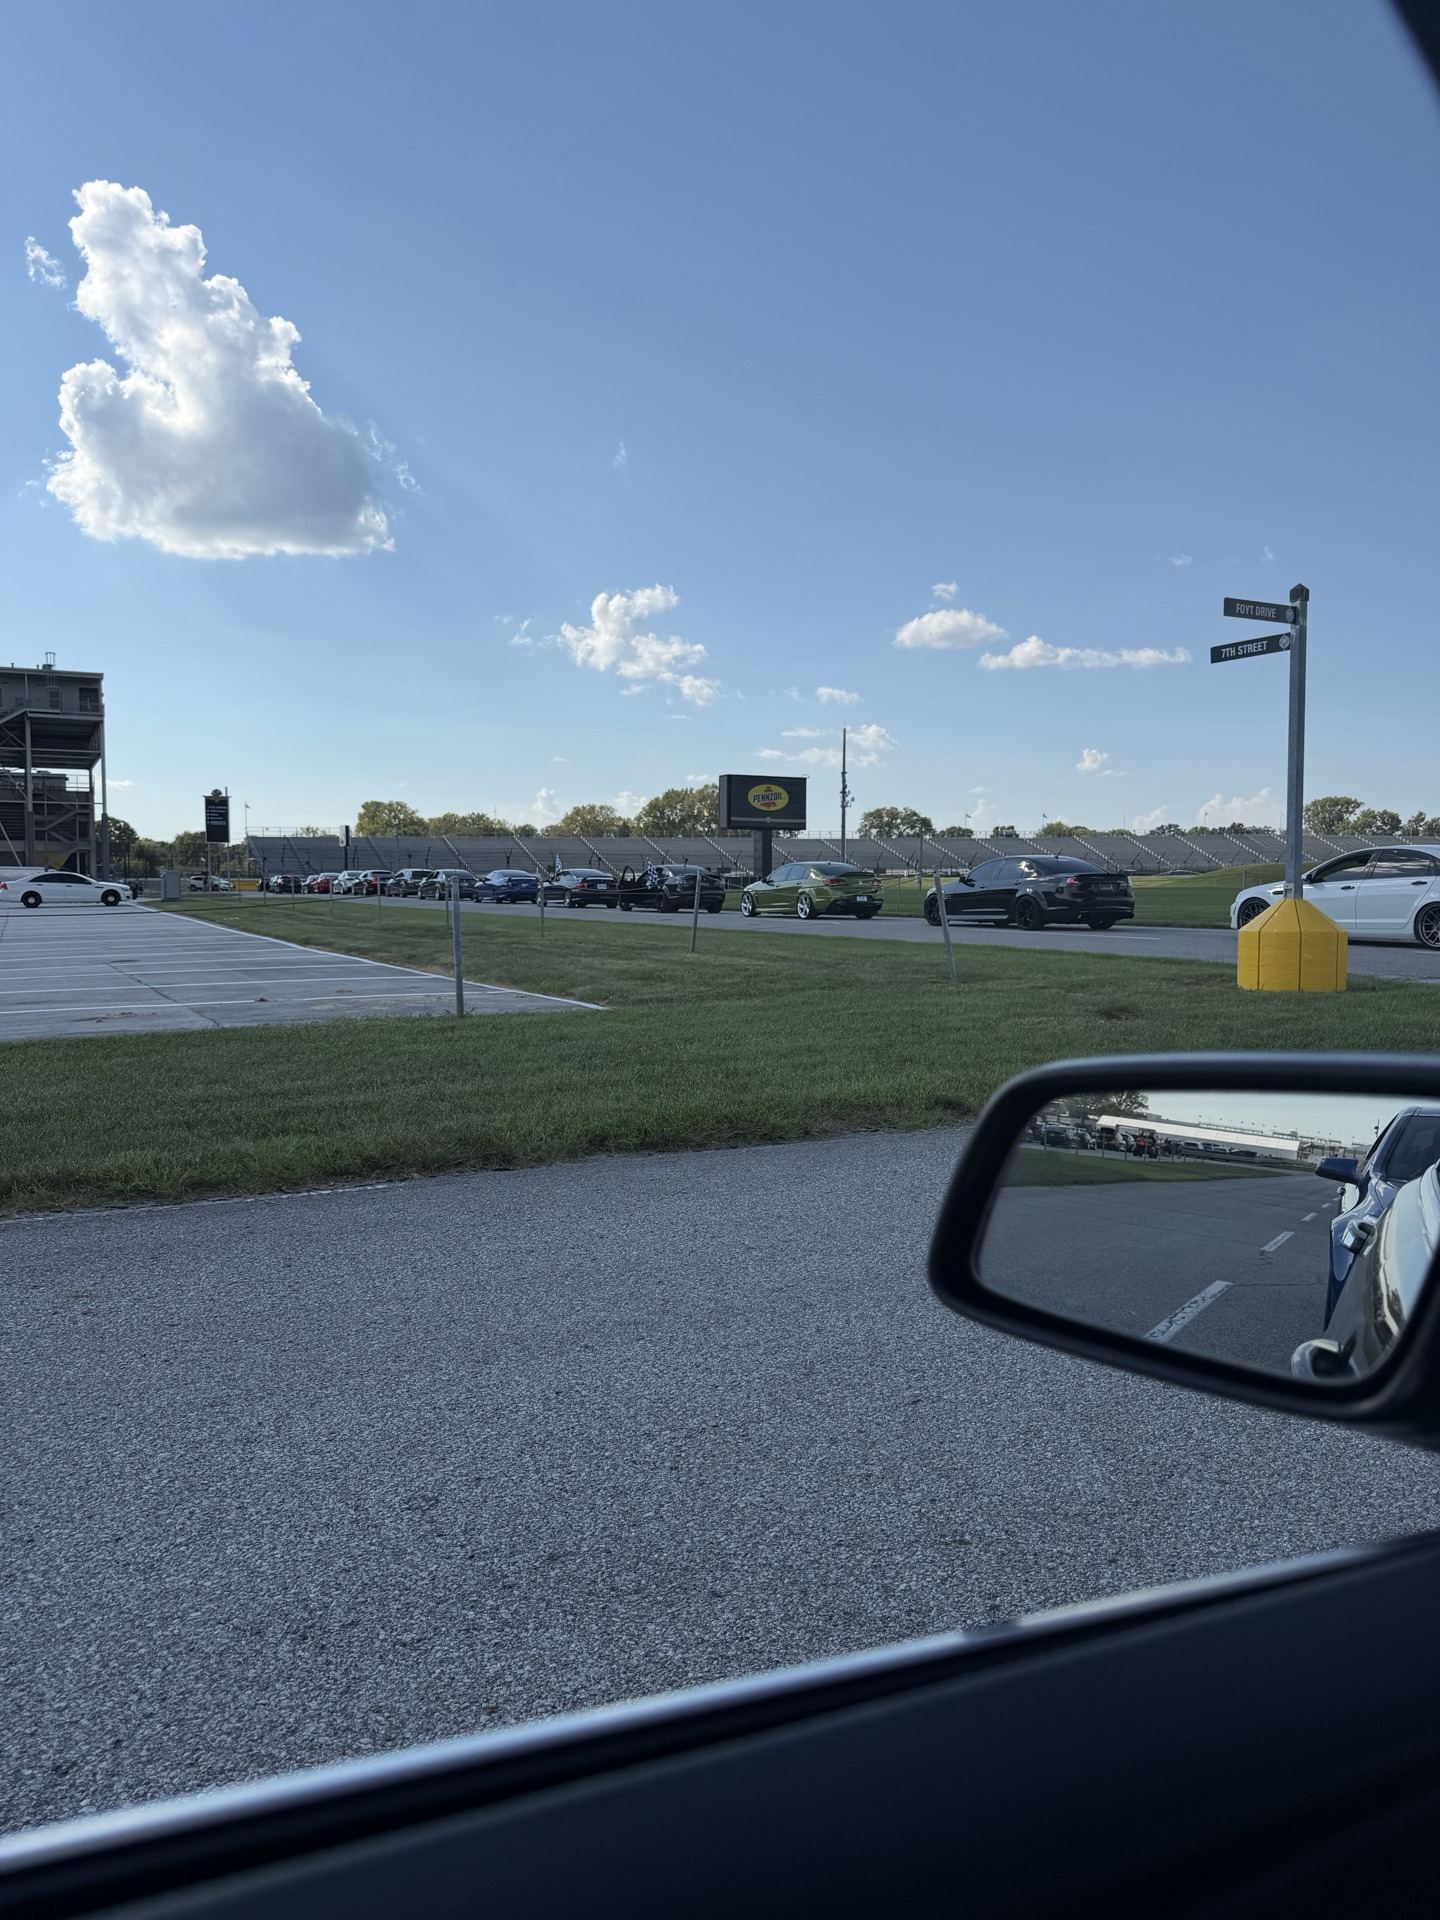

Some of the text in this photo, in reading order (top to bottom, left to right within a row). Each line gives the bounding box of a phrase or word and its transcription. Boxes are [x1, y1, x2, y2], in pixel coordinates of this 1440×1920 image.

[1235, 603, 1277, 618] FOYT DRIVE
[1220, 640, 1268, 658] 7TH STREET
[753, 792, 783, 803] PENNZOIL
